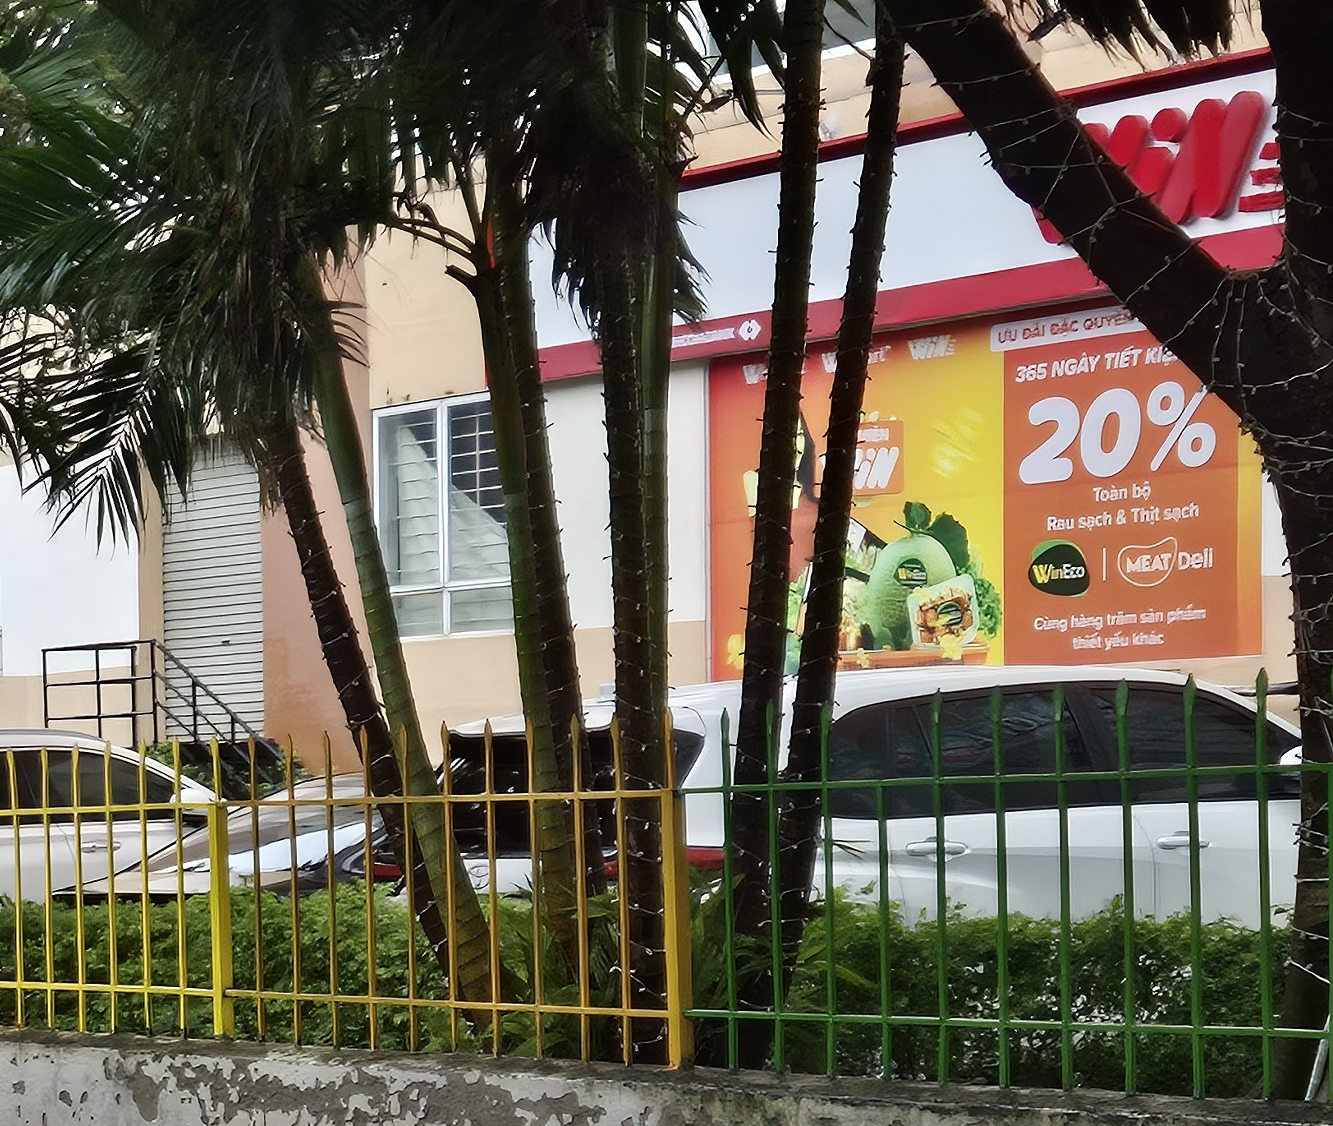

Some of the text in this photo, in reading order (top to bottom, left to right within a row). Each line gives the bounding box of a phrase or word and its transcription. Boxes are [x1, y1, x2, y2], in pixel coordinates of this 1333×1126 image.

[1015, 344, 1180, 383] 365 NGÀY TIẾT KIỆ
[1019, 381, 1217, 485] 20%
[1092, 480, 1151, 502] Toàn bộ
[1046, 501, 1200, 532] Rau sạch & Thịt sạch
[1032, 563, 1085, 584] WinEco
[1126, 552, 1172, 574] MEAT
